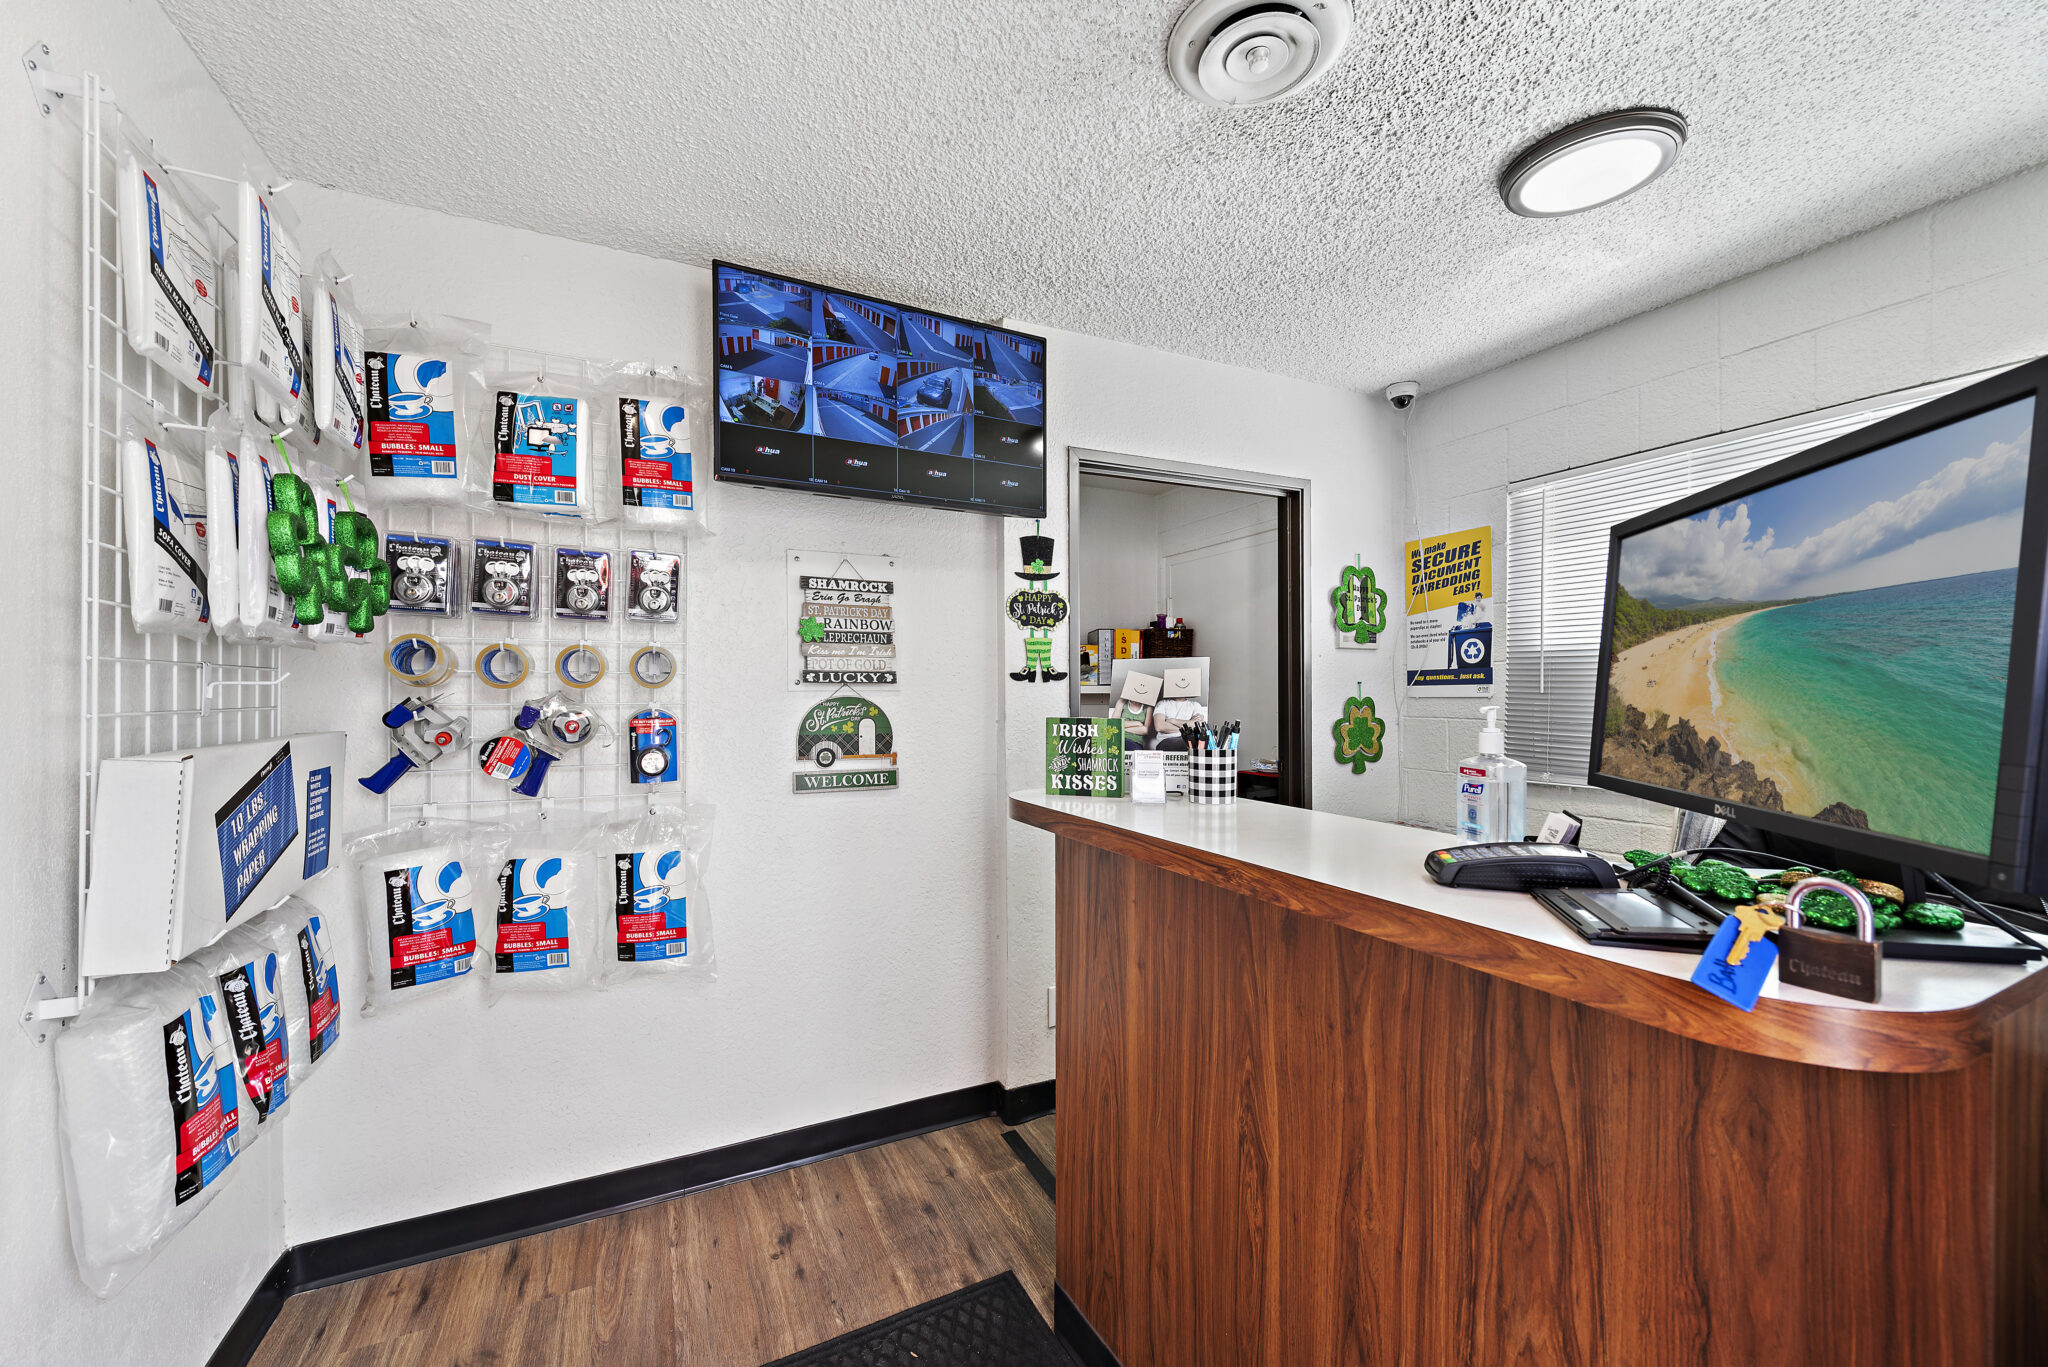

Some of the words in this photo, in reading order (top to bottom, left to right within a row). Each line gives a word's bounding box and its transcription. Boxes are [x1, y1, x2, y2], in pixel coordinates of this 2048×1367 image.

[154, 262, 173, 294] QUEEN
[370, 370, 383, 409] Chateau
[498, 404, 509, 442] Chateau
[625, 412, 637, 448] Chateau
[381, 442, 416, 450] BUBBLES:
[154, 466, 164, 512] Chateau
[158, 528, 174, 546] SOFA
[174, 545, 192, 568] COVER
[1424, 542, 1446, 555] make
[1412, 540, 1481, 573] SECURE
[1412, 556, 1481, 585] DOCUMENT
[808, 578, 887, 593] SHAMROCK
[1412, 569, 1480, 596] SHREDDING
[1453, 581, 1480, 595] EASY!
[812, 592, 833, 601] Erin
[837, 593, 850, 602] Go
[854, 594, 881, 604] Bragh
[1024, 593, 1053, 602] HAPPY
[824, 606, 869, 618] PATRICK'S
[870, 608, 888, 619] DAY
[1026, 602, 1064, 619] Patrick's
[824, 618, 892, 631] RAINBOW
[1029, 616, 1048, 624] DAY
[824, 632, 887, 644] LEPRECHAUN
[808, 644, 829, 656] Kiss
[849, 646, 866, 656] I'm
[869, 646, 893, 657] Irish
[812, 658, 832, 670] POT
[834, 658, 851, 671] OF
[855, 658, 887, 671] GOLD
[818, 672, 884, 684] LUCKY
[1052, 724, 1098, 737] IRISH
[1056, 737, 1105, 754] Wishes
[1078, 758, 1118, 772] SHAMROCK
[804, 773, 889, 788] WELCOME
[1051, 774, 1117, 790] KISSES
[1464, 783, 1482, 794] Purell
[231, 814, 244, 838] 10
[246, 791, 267, 821] LBS.
[1714, 804, 1736, 818] DELL
[233, 805, 279, 867] WRAPPING
[236, 849, 266, 895] PAPER
[618, 870, 628, 905] Chateau
[392, 886, 403, 926] Chateau
[656, 929, 677, 937] SMALL
[535, 939, 558, 947] SMALL
[403, 950, 440, 962] BUBBLES:
[441, 944, 466, 954] SMALL
[303, 949, 316, 991] Chateau
[1789, 958, 1863, 985] Chateau
[232, 992, 258, 1041] Chateau
[177, 1045, 193, 1104] Chateau
